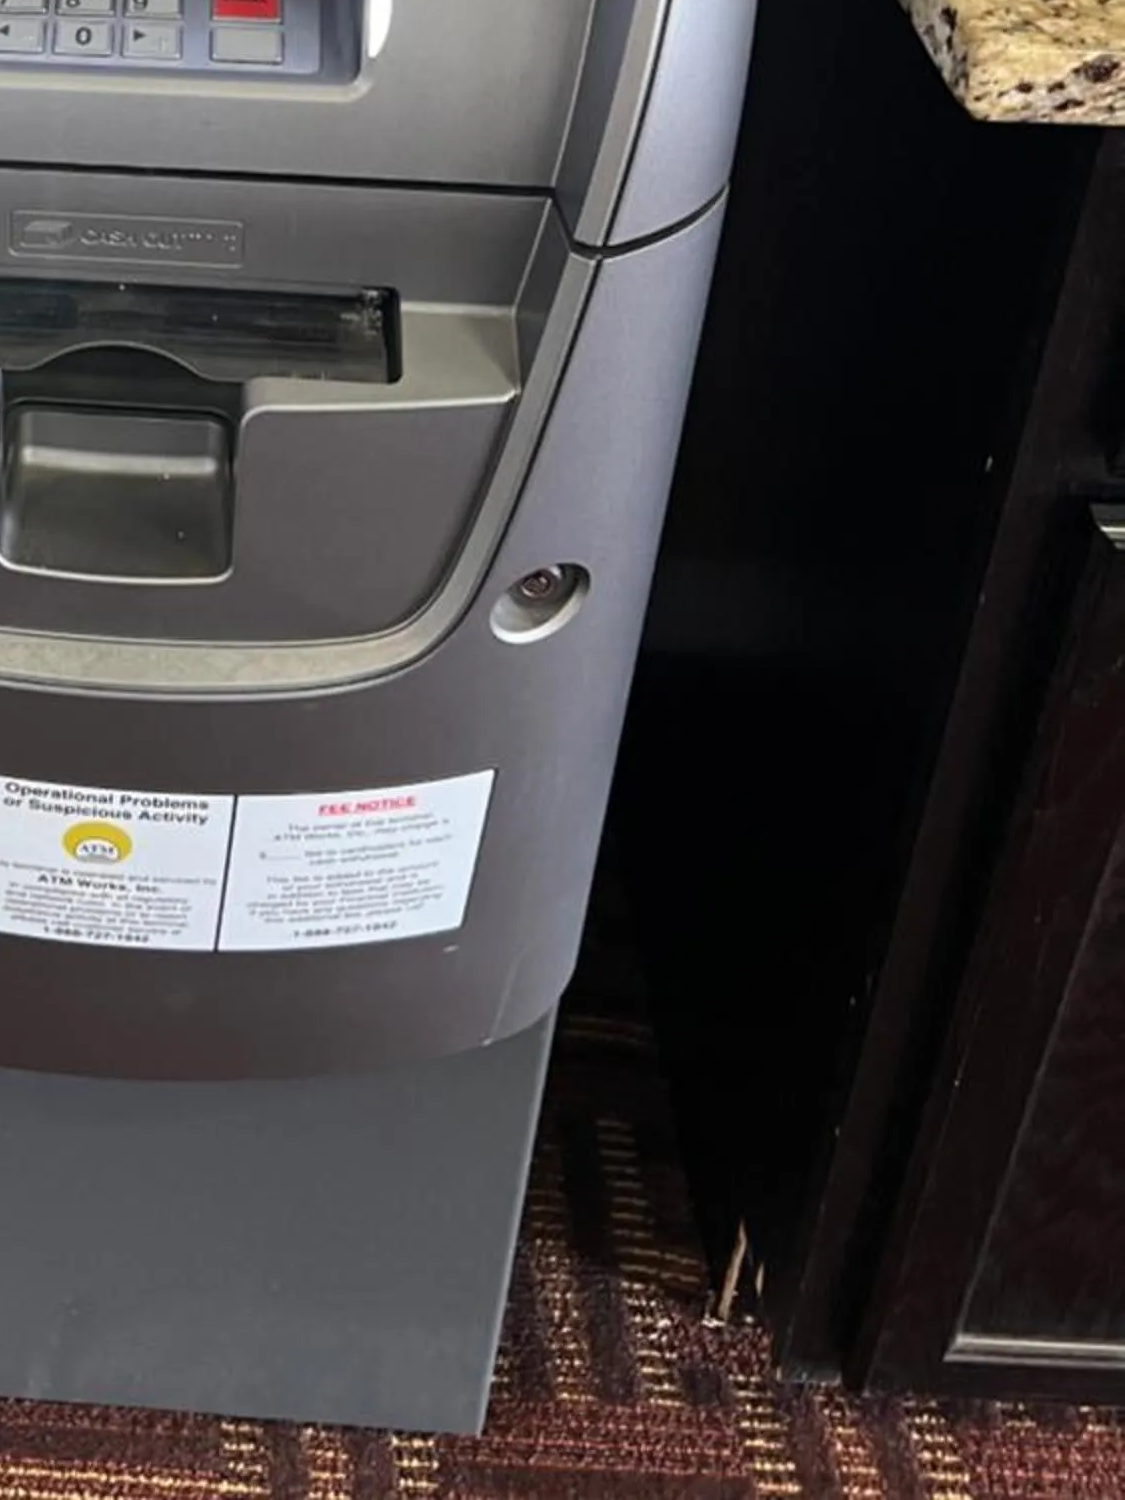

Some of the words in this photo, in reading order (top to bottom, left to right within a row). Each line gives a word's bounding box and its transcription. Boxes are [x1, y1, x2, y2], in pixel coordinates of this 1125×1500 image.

[75, 26, 92, 45] 0
[4, 781, 114, 805] Operational
[119, 793, 209, 811] Problems
[318, 801, 350, 816] FEE
[355, 796, 416, 814] NOTICE
[3, 797, 21, 808] or
[28, 799, 132, 819] Suspicious
[138, 809, 209, 826] Activity
[79, 842, 115, 855] ATM
[37, 873, 73, 886] ATM
[76, 877, 129, 893] Works,
[135, 882, 162, 894] Inc.
